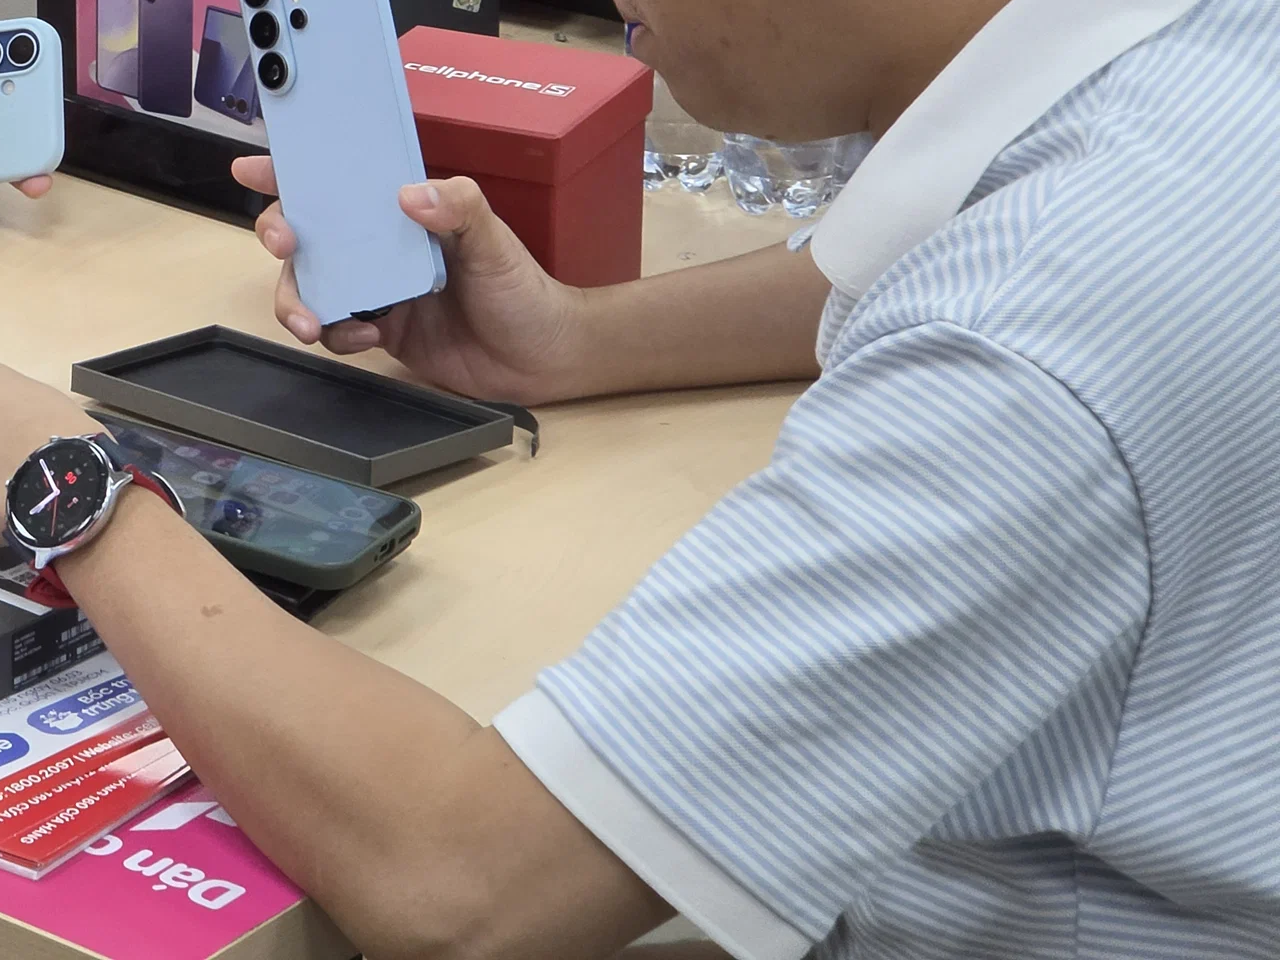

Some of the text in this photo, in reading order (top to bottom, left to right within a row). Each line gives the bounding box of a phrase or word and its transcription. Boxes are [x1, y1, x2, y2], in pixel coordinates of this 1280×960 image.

[77, 687, 113, 705] Bốc
[4, 757, 76, 795] 1800.2097
[2, 801, 30, 820] CỬA
[54, 806, 80, 827] CỬA
[20, 821, 57, 845] HÀNG
[123, 849, 247, 910] Dán
